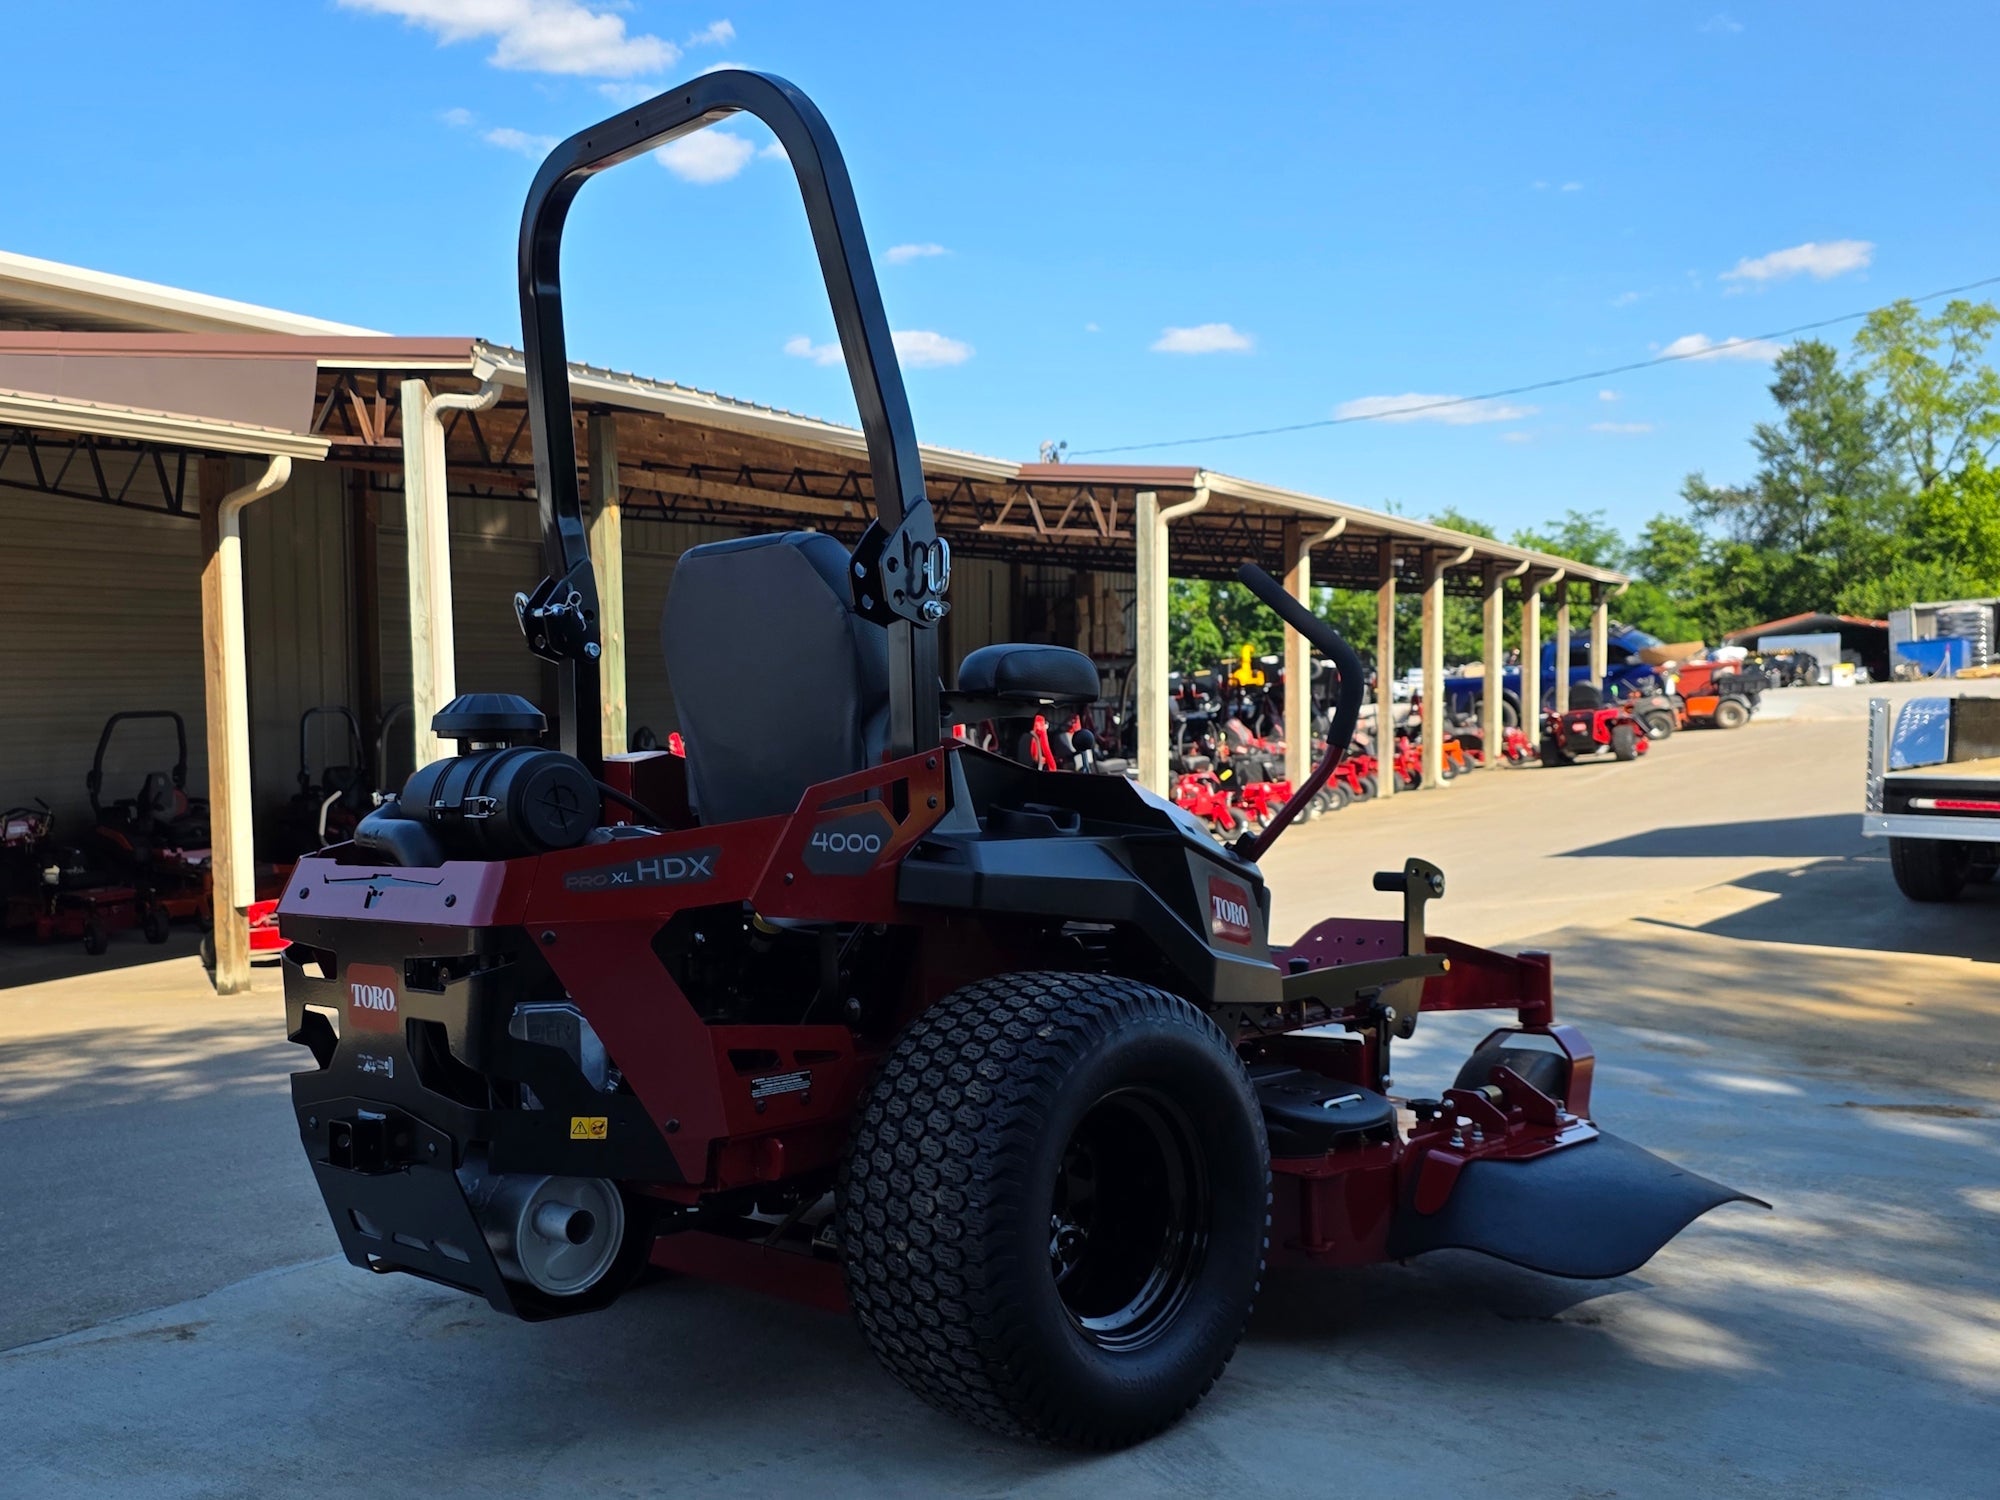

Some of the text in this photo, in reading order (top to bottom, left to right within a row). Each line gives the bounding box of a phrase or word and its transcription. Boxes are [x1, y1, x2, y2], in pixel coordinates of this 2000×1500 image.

[812, 833, 880, 853] 4000
[566, 856, 712, 889] PRO XL HDX
[1213, 896, 1248, 927] TORO
[351, 983, 395, 1011] TORO
